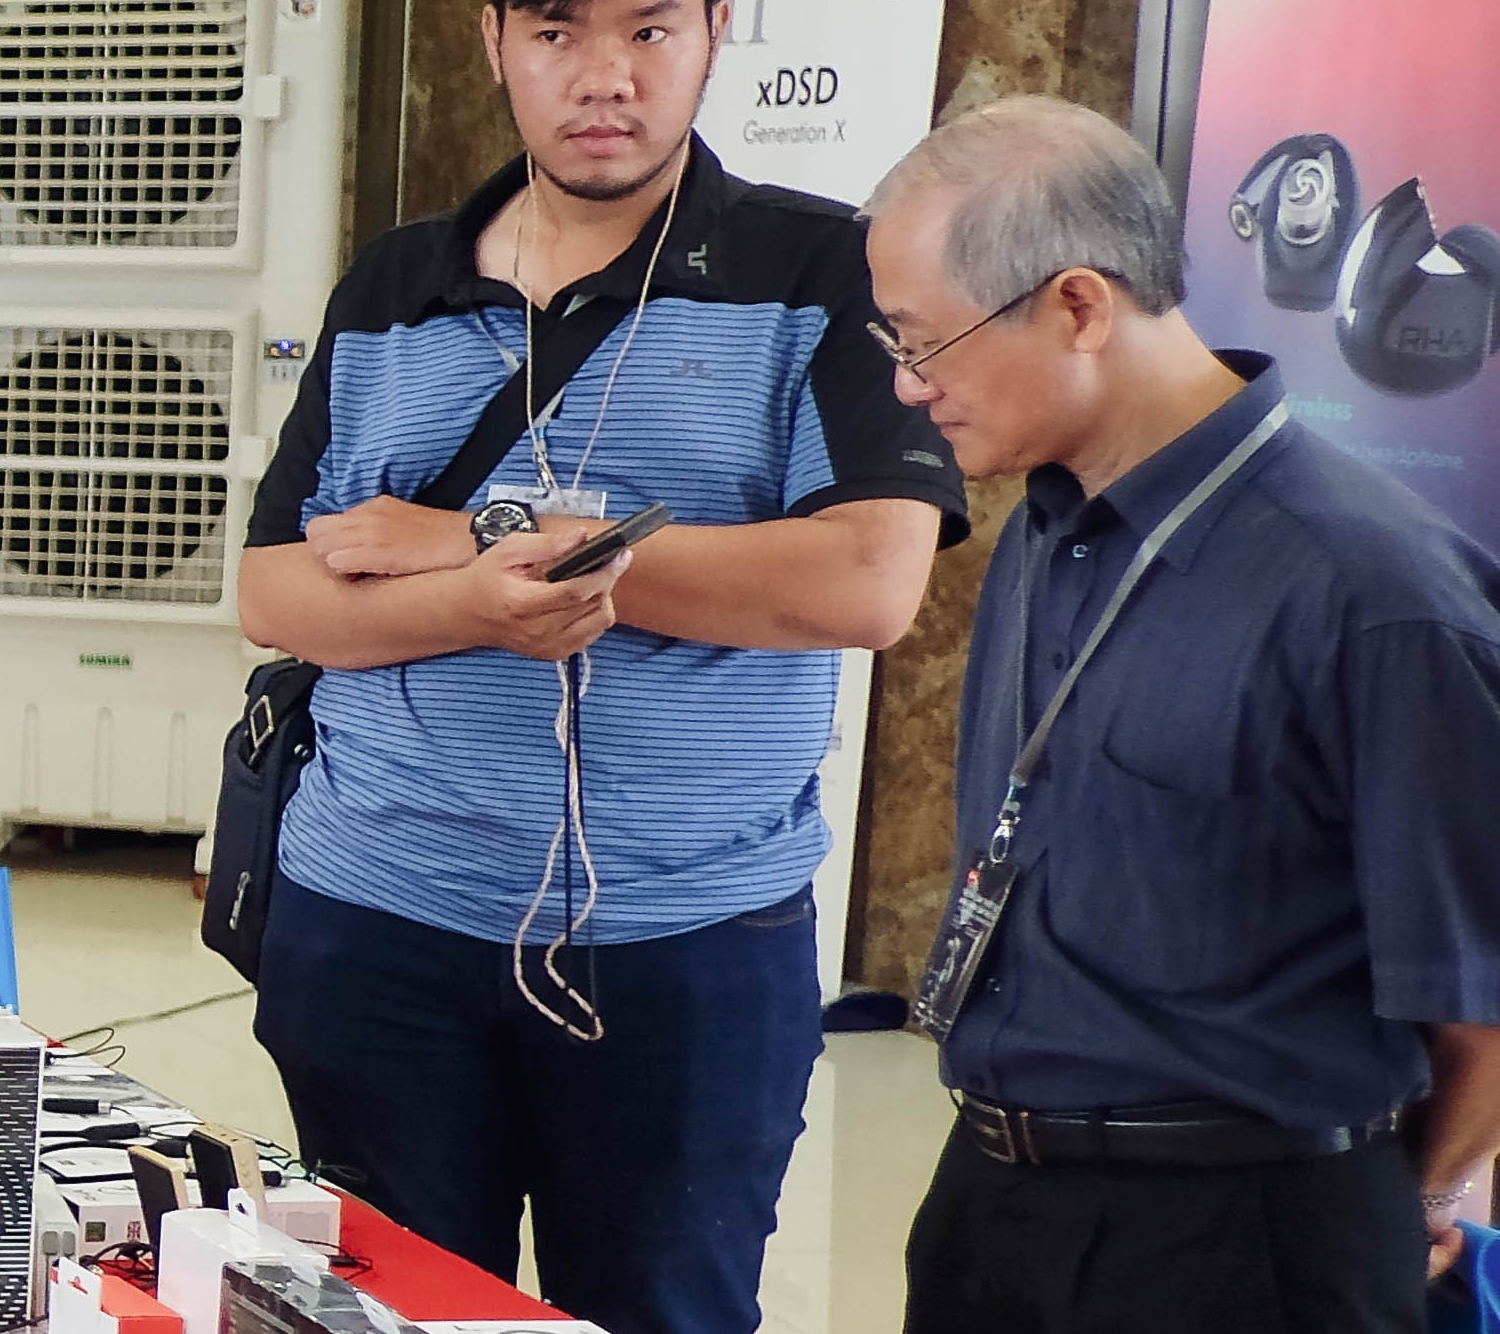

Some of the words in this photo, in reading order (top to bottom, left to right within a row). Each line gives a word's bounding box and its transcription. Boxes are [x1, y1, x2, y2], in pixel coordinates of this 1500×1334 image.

[756, 65, 839, 108] xDSD
[743, 119, 828, 146] Generation
[834, 118, 847, 143] X
